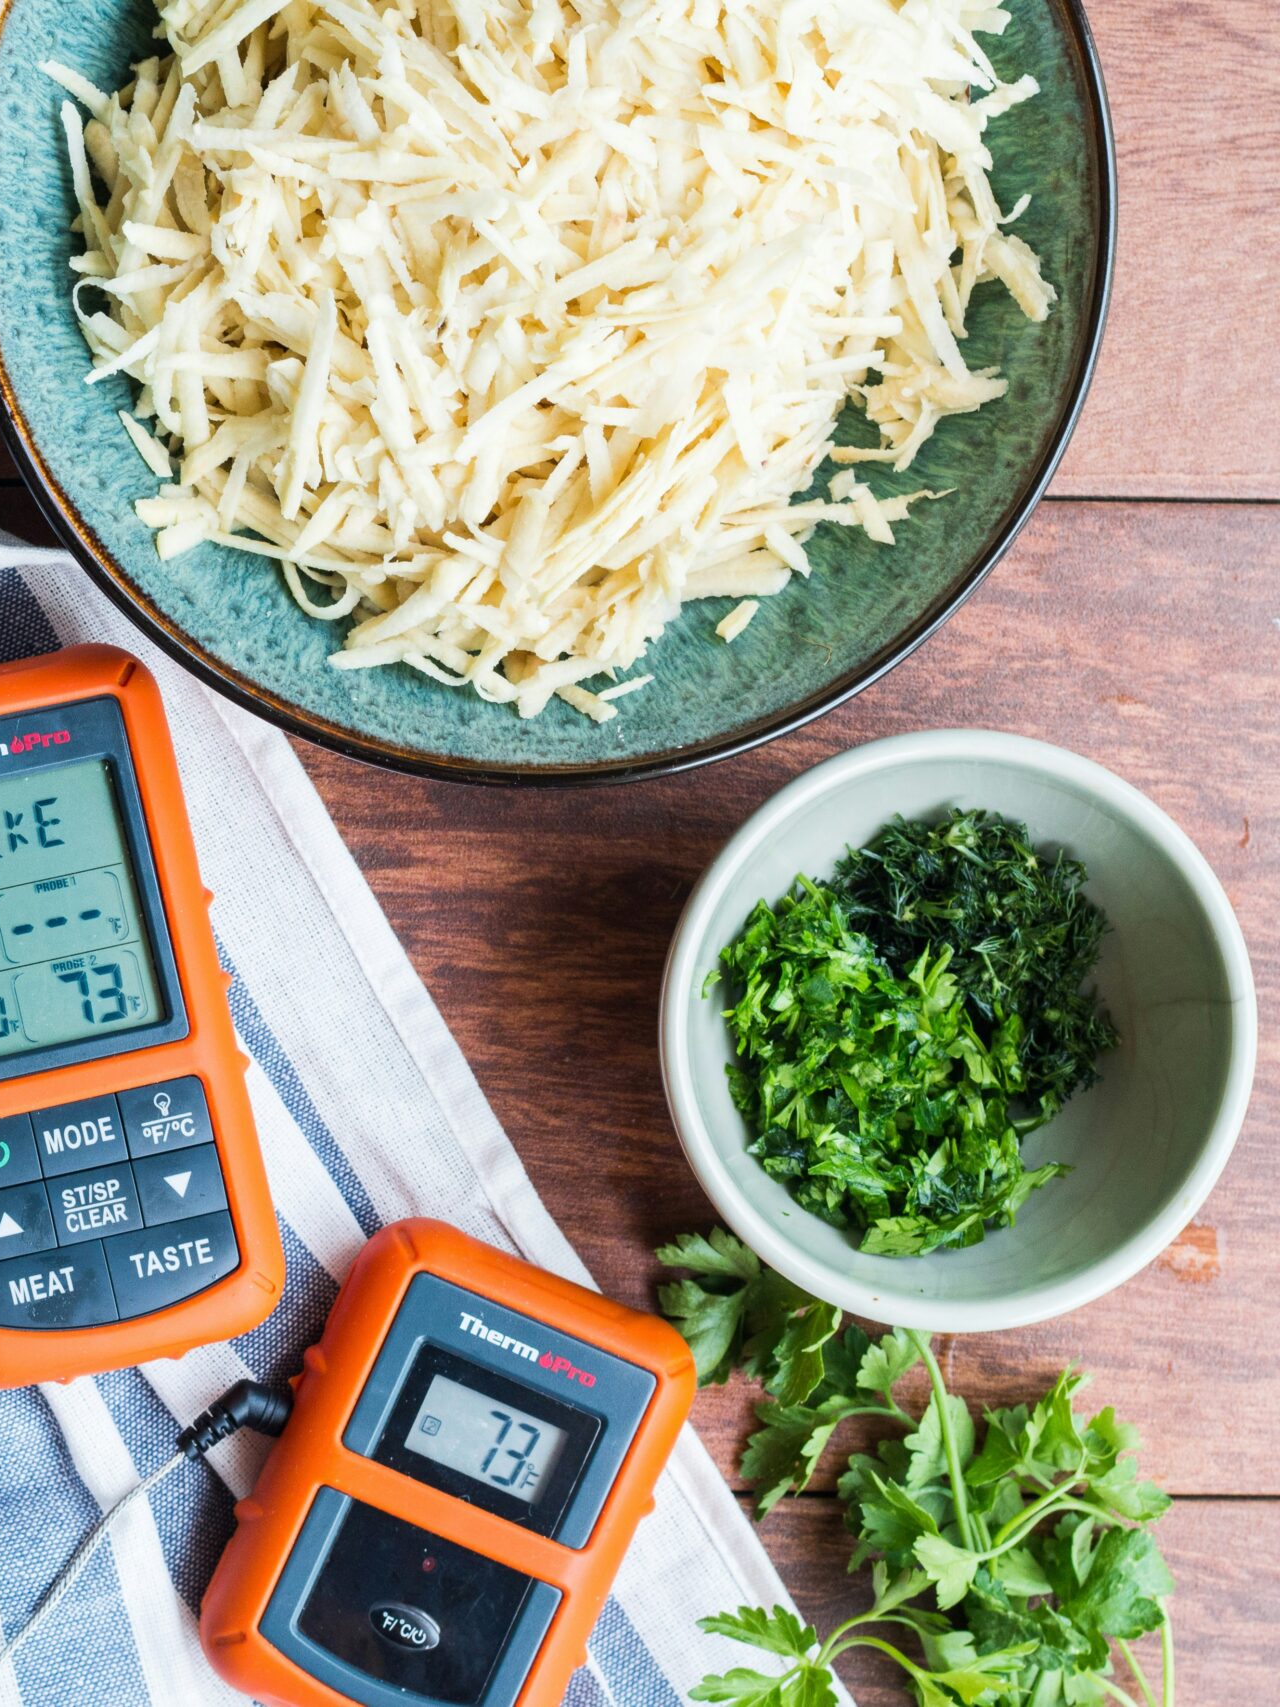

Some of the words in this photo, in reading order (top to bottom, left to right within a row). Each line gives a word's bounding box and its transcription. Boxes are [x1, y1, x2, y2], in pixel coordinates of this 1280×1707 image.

[34, 878, 69, 894] PROBE
[52, 958, 85, 974] PROBE
[89, 954, 98, 966] 2
[43, 1117, 116, 1155] MODE
[61, 1178, 121, 1209] ST/SP
[65, 1203, 128, 1234] CLEAR
[129, 1238, 214, 1279] TASTE
[9, 1266, 75, 1306] MEAT
